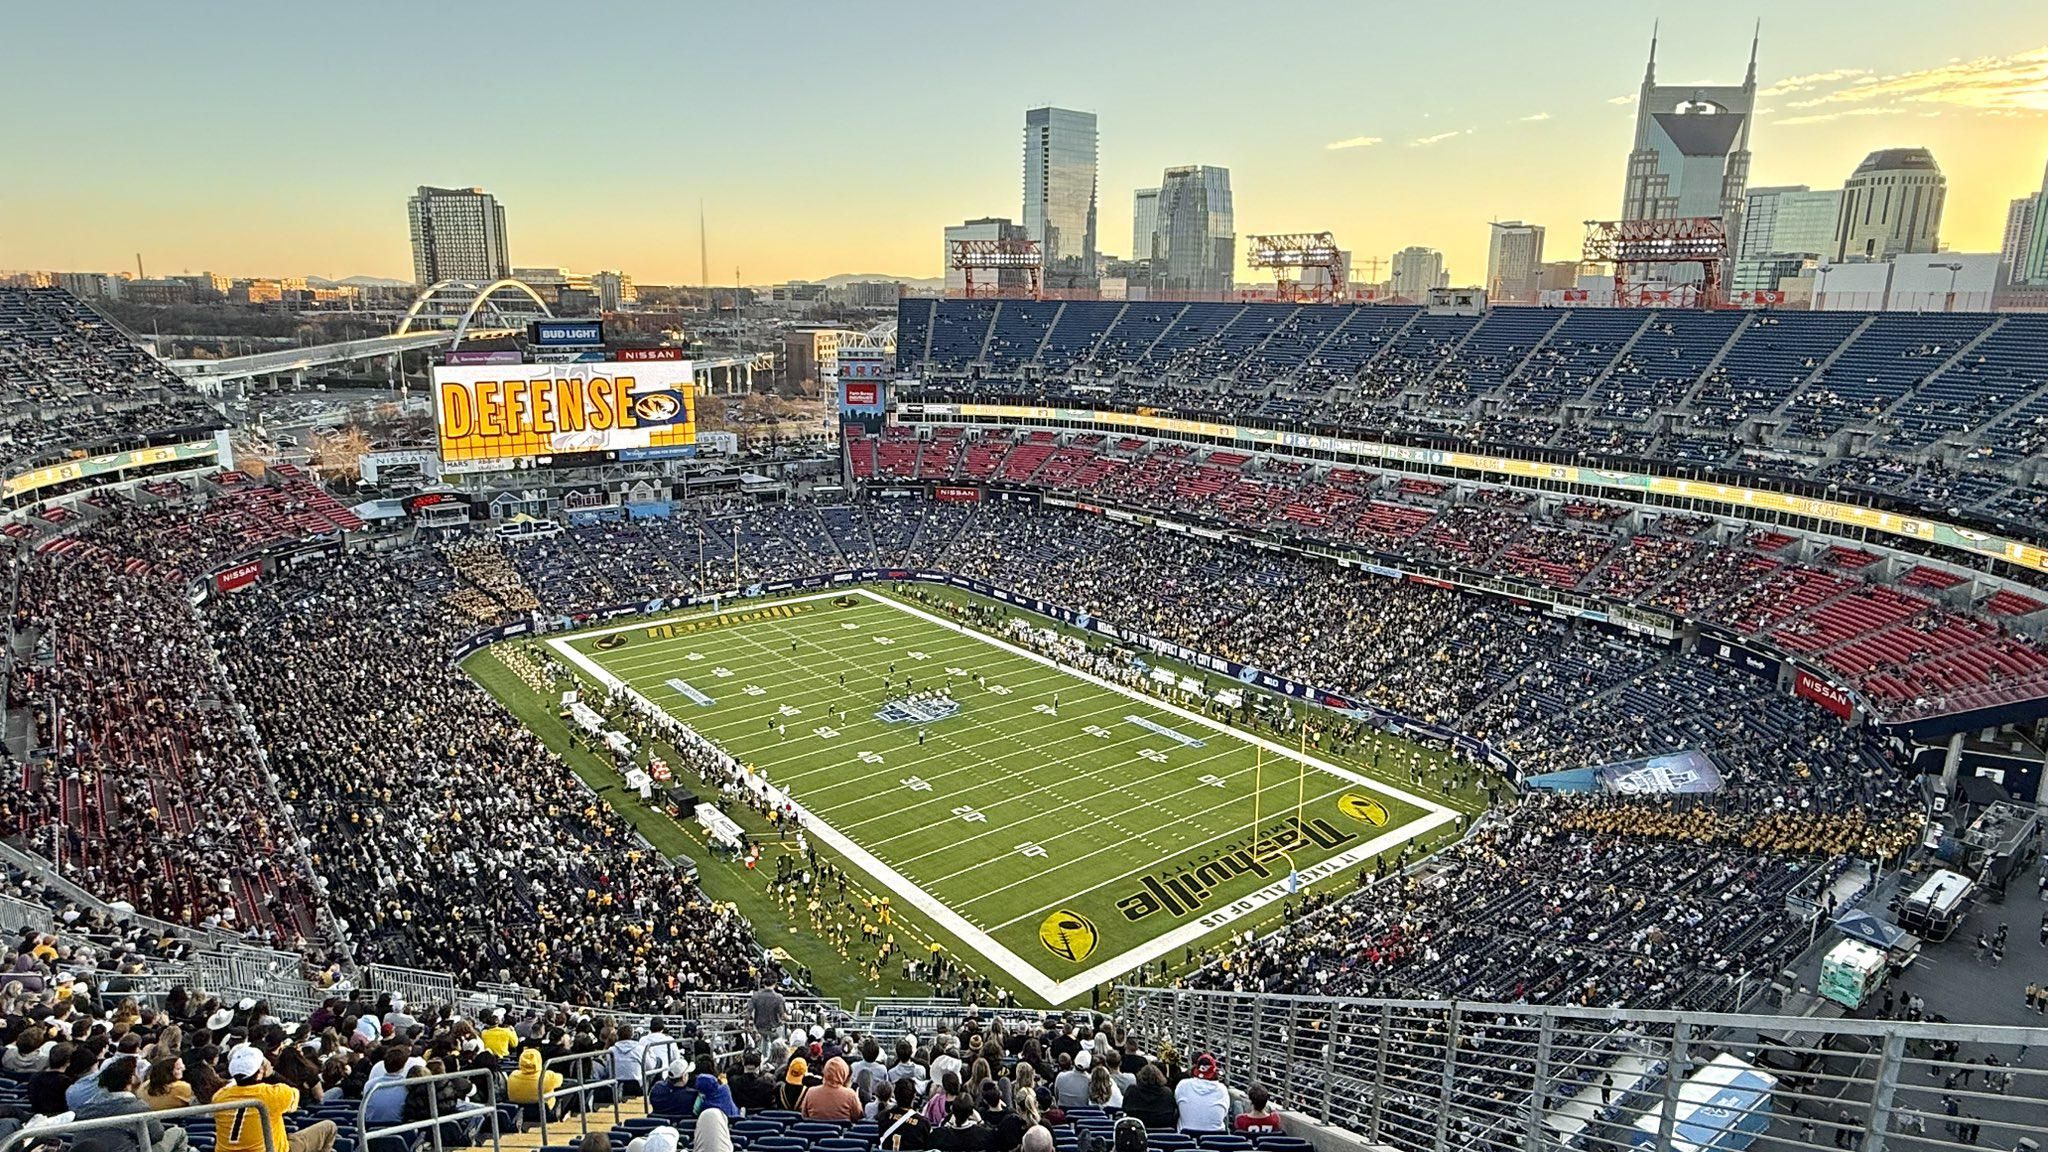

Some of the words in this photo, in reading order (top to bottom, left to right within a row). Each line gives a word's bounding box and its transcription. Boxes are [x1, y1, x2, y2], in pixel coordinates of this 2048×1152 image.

[542, 330, 566, 339] BUD
[567, 329, 597, 339] LIGHT
[625, 350, 675, 359] NISSAN
[441, 377, 637, 439] DEFENSE
[376, 455, 428, 465] NISSAN
[940, 489, 975, 497] NISSAN
[223, 565, 257, 582] NISSAN
[1198, 653, 1211, 667] CITY
[1802, 677, 1847, 706] NISSAN
[900, 776, 932, 792] 30
[950, 804, 986, 823] 20
[1226, 823, 1287, 852] MUSIC
[1013, 841, 1047, 858] 10
[1342, 852, 1360, 864] IT
[1115, 816, 1358, 922] Nashville
[1162, 855, 1210, 880] CITY
[1254, 883, 1288, 902] ALL
[1228, 901, 1254, 916] OF
[1199, 913, 1229, 929] US
[888, 1111, 919, 1126] TIGRS
